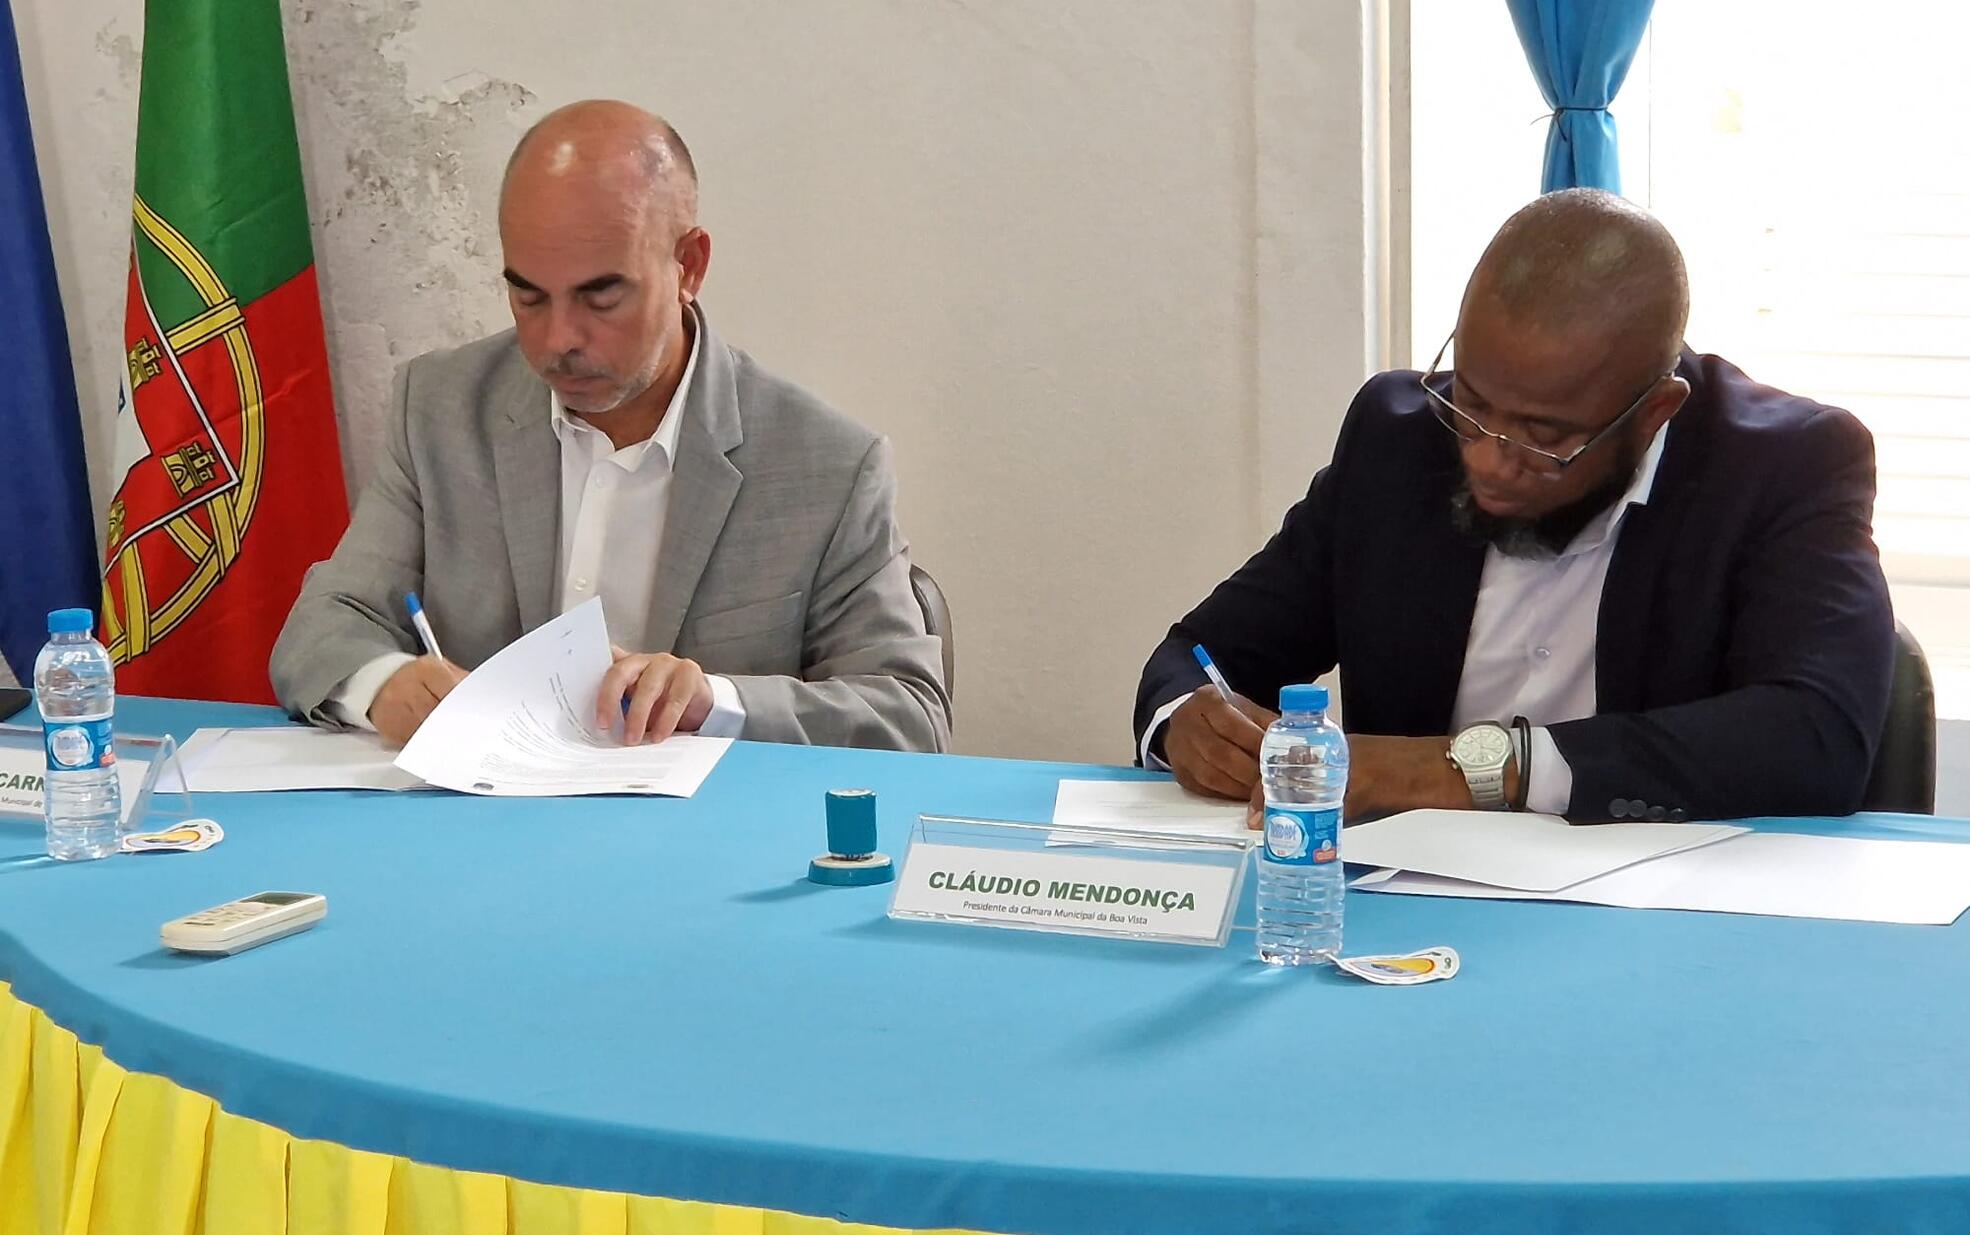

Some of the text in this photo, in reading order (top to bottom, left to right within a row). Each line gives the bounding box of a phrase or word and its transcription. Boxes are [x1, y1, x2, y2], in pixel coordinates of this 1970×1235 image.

[929, 870, 1195, 913] CLÁUDIO MENDONÇA
[963, 901, 1148, 925] Presidente da Câmara Municipal da Boa Vista
